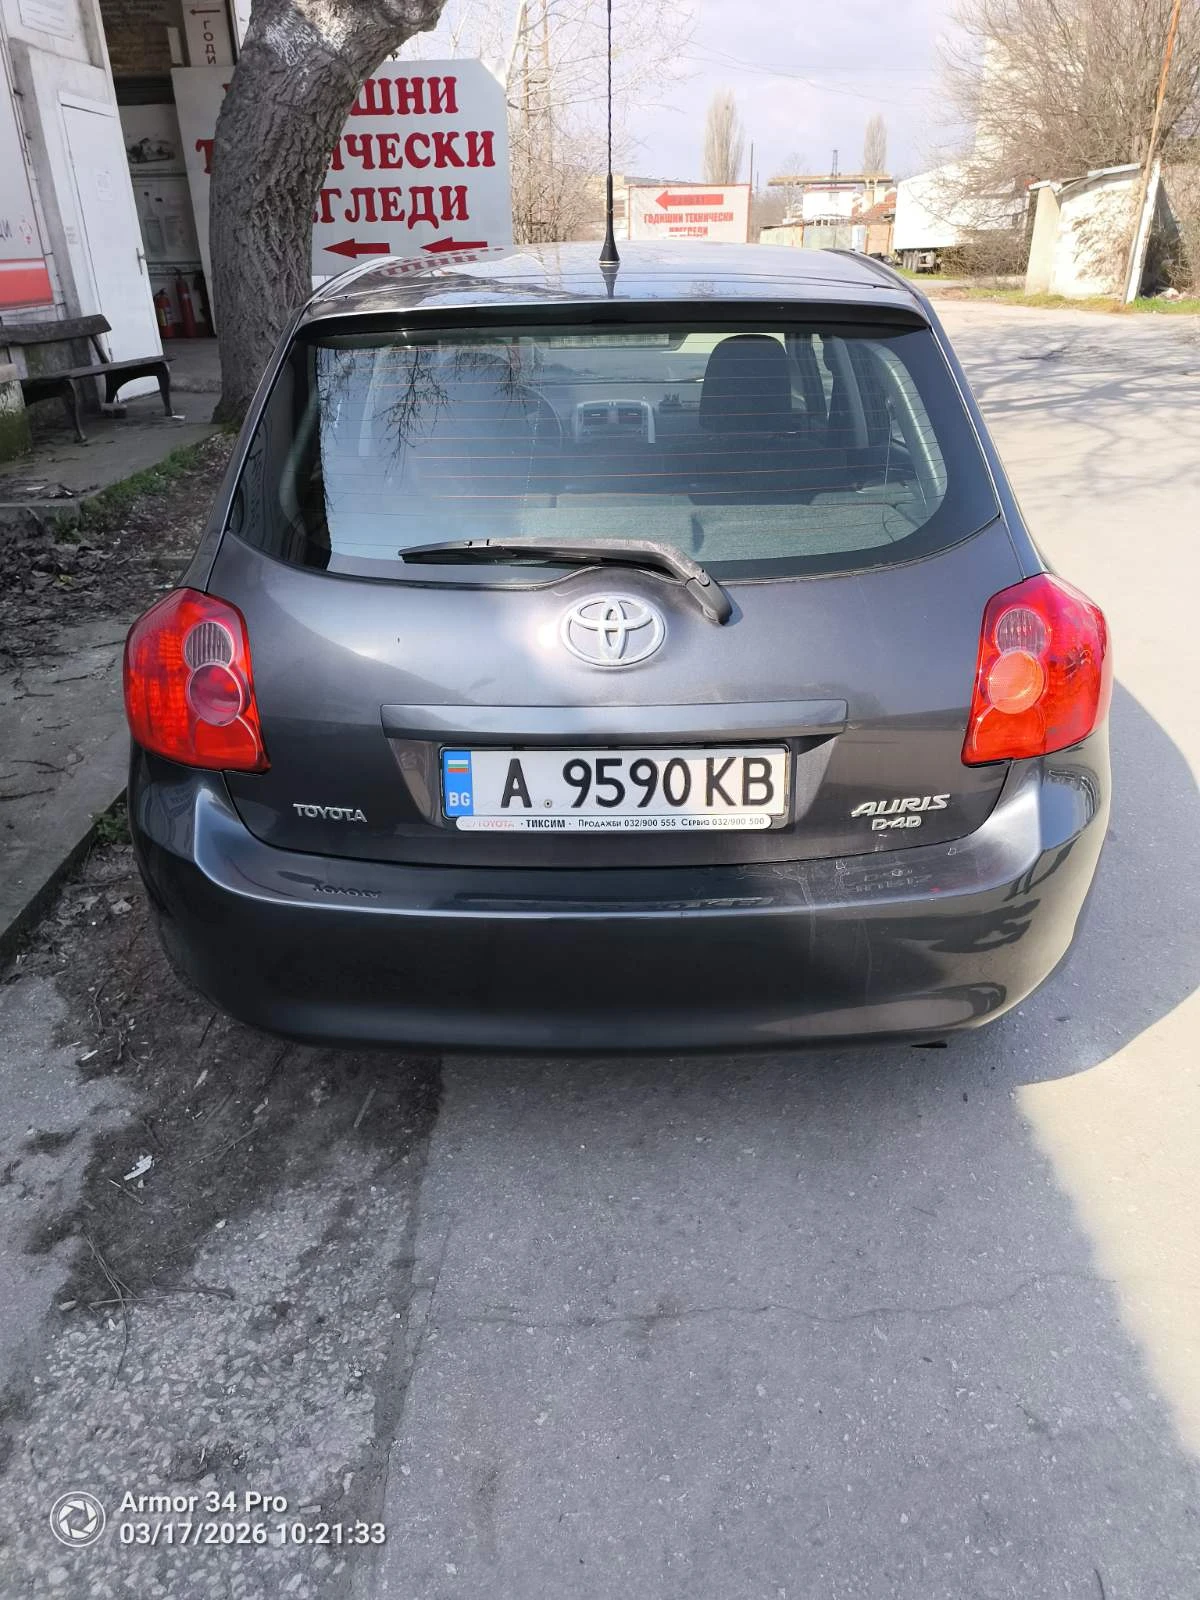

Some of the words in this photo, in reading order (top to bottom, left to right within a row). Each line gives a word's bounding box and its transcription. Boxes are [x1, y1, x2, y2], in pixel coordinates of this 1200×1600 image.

[313, 185, 470, 229] ГЛЕДИ
[563, 757, 692, 808] 9590
[449, 792, 471, 807] BG
[851, 793, 951, 818] AURIS
[292, 803, 368, 823] TOYOTA
[526, 819, 566, 828] ТИКСИМ
[624, 818, 658, 828] 032/900
[660, 818, 676, 827] 555
[712, 817, 746, 827] 032/900
[872, 815, 922, 831] D-4D
